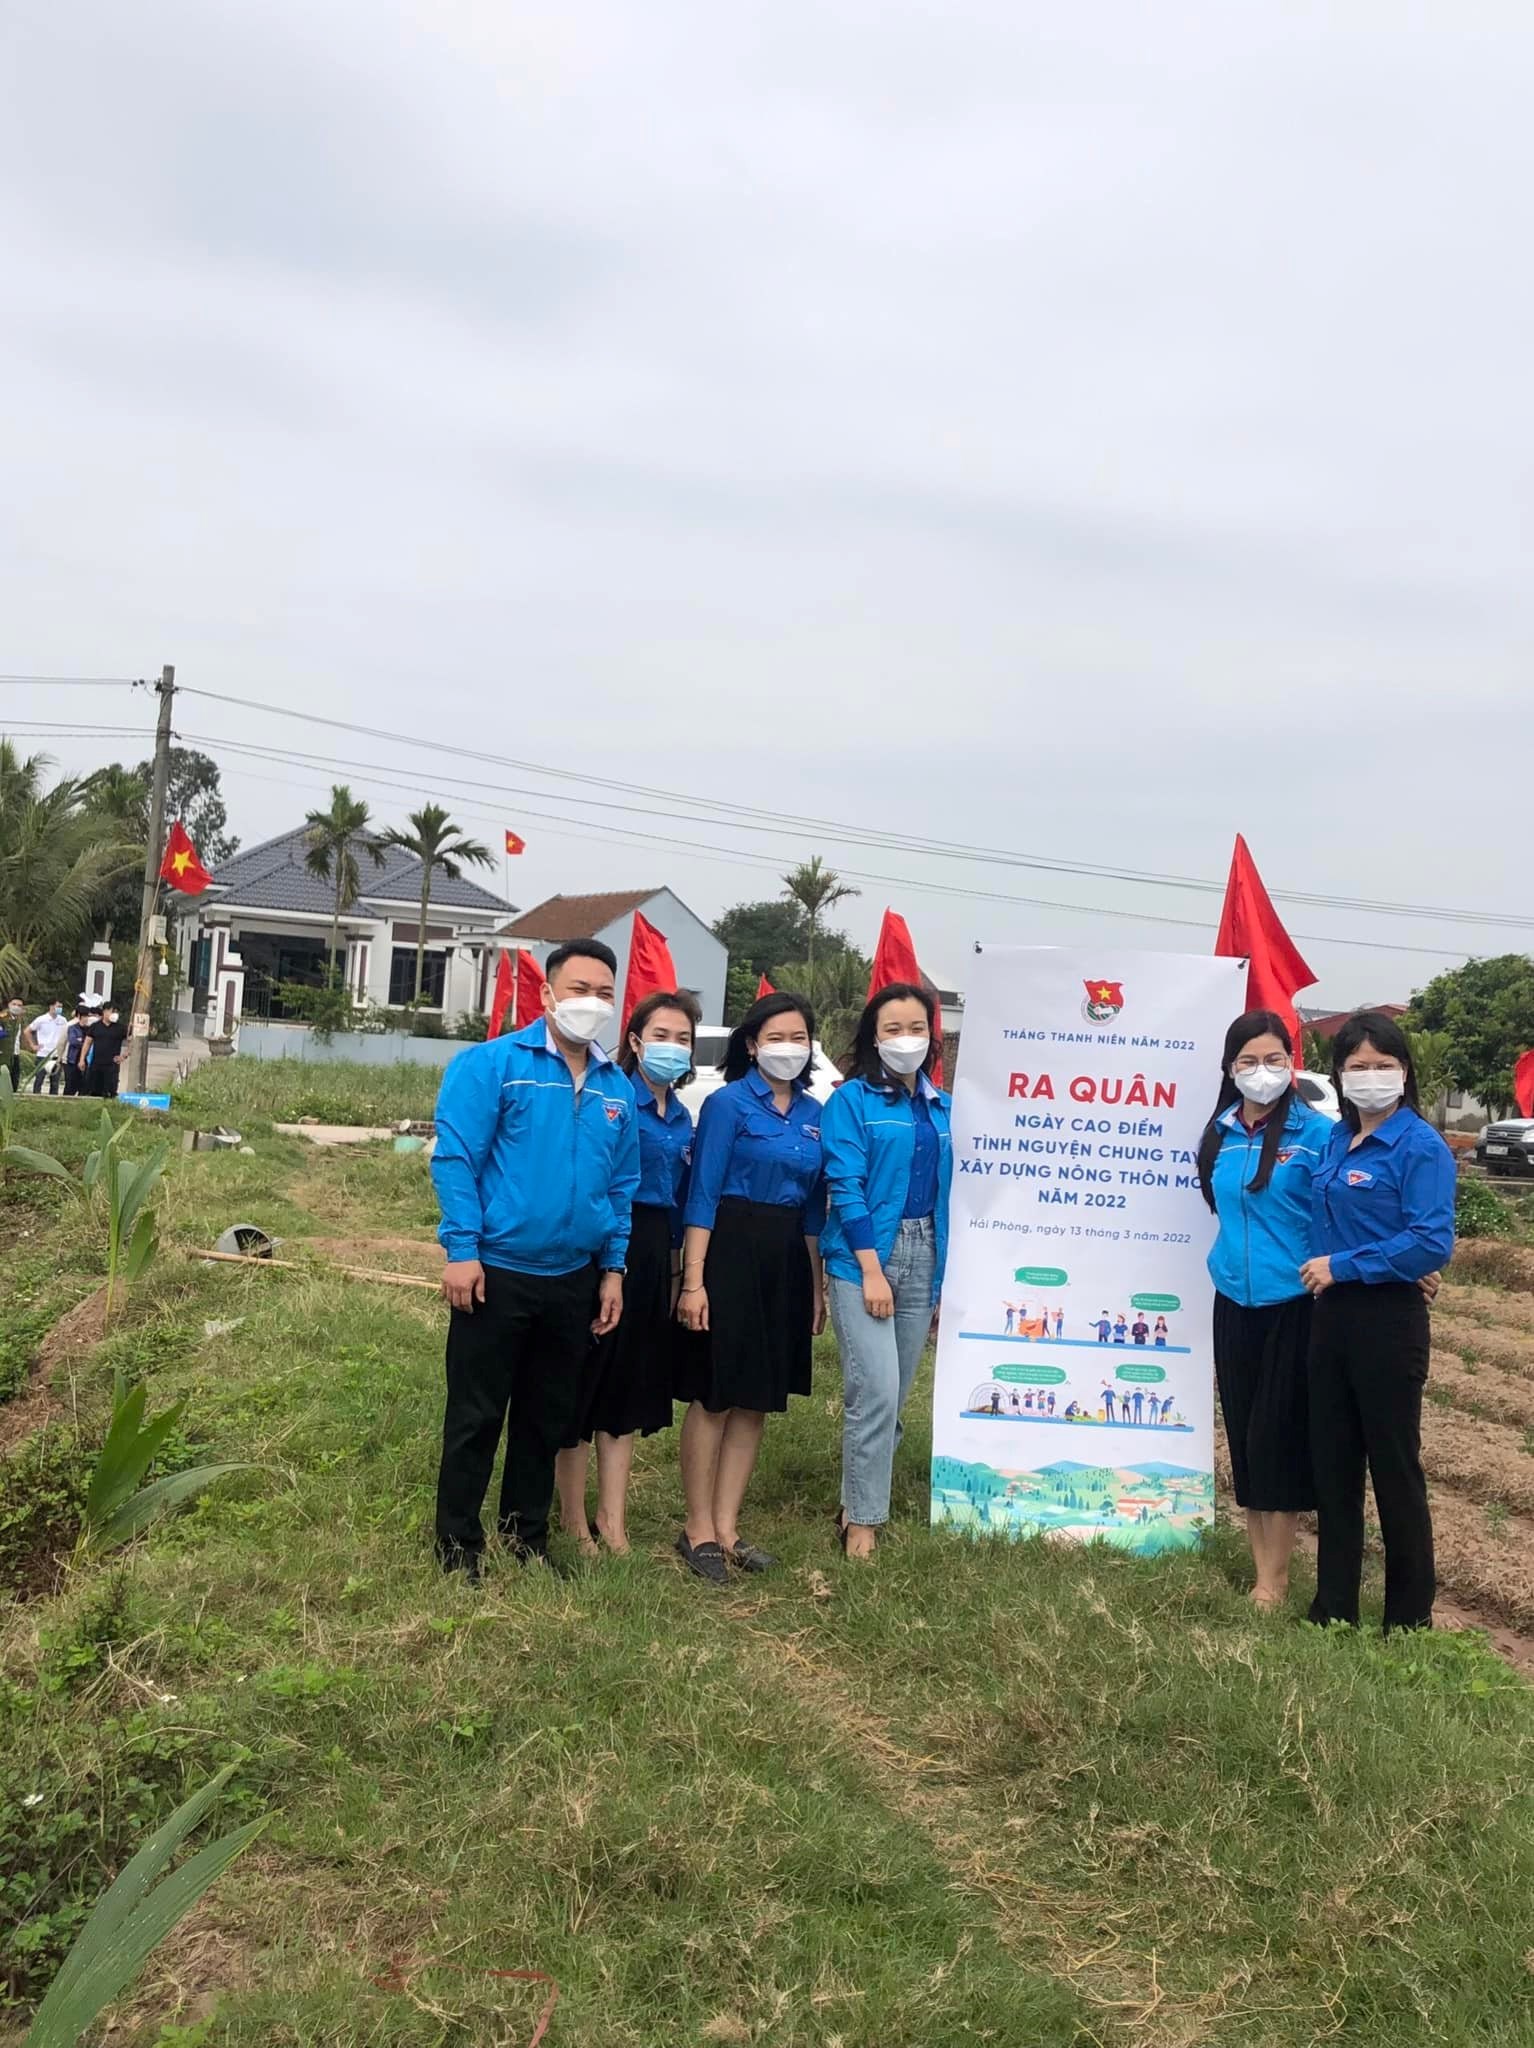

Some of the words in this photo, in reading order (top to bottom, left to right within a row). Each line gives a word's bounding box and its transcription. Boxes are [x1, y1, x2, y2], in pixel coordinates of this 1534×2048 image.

[1003, 1028, 1045, 1040] THÁNG
[1051, 1031, 1093, 1044] THANH
[1097, 1034, 1126, 1045] NIÊN
[1131, 1036, 1160, 1048] NĂM
[1164, 1039, 1195, 1050] 2022
[1008, 1072, 1055, 1099] RA
[1069, 1073, 1177, 1108] QUÂN
[1015, 1113, 1065, 1130] NGÀY
[1071, 1118, 1112, 1133] CAO
[1118, 1119, 1163, 1137] ĐIỂM
[973, 1135, 1012, 1151] TÌNH
[1018, 1140, 1092, 1158] NGUYỆN
[1098, 1145, 1164, 1161] CHUNG
[959, 1159, 993, 1175] XÂY
[1000, 1163, 1051, 1180] DỰNG
[1058, 1165, 1112, 1183] NÔNG
[1119, 1170, 1169, 1186] THÔN
[1038, 1187, 1078, 1205] NĂM
[1084, 1193, 1127, 1208] 2022
[1036, 1224, 1066, 1237] ngày
[1070, 1226, 1081, 1235] 13
[1123, 1229, 1131, 1239] 3
[1163, 1232, 1191, 1244] 2022
